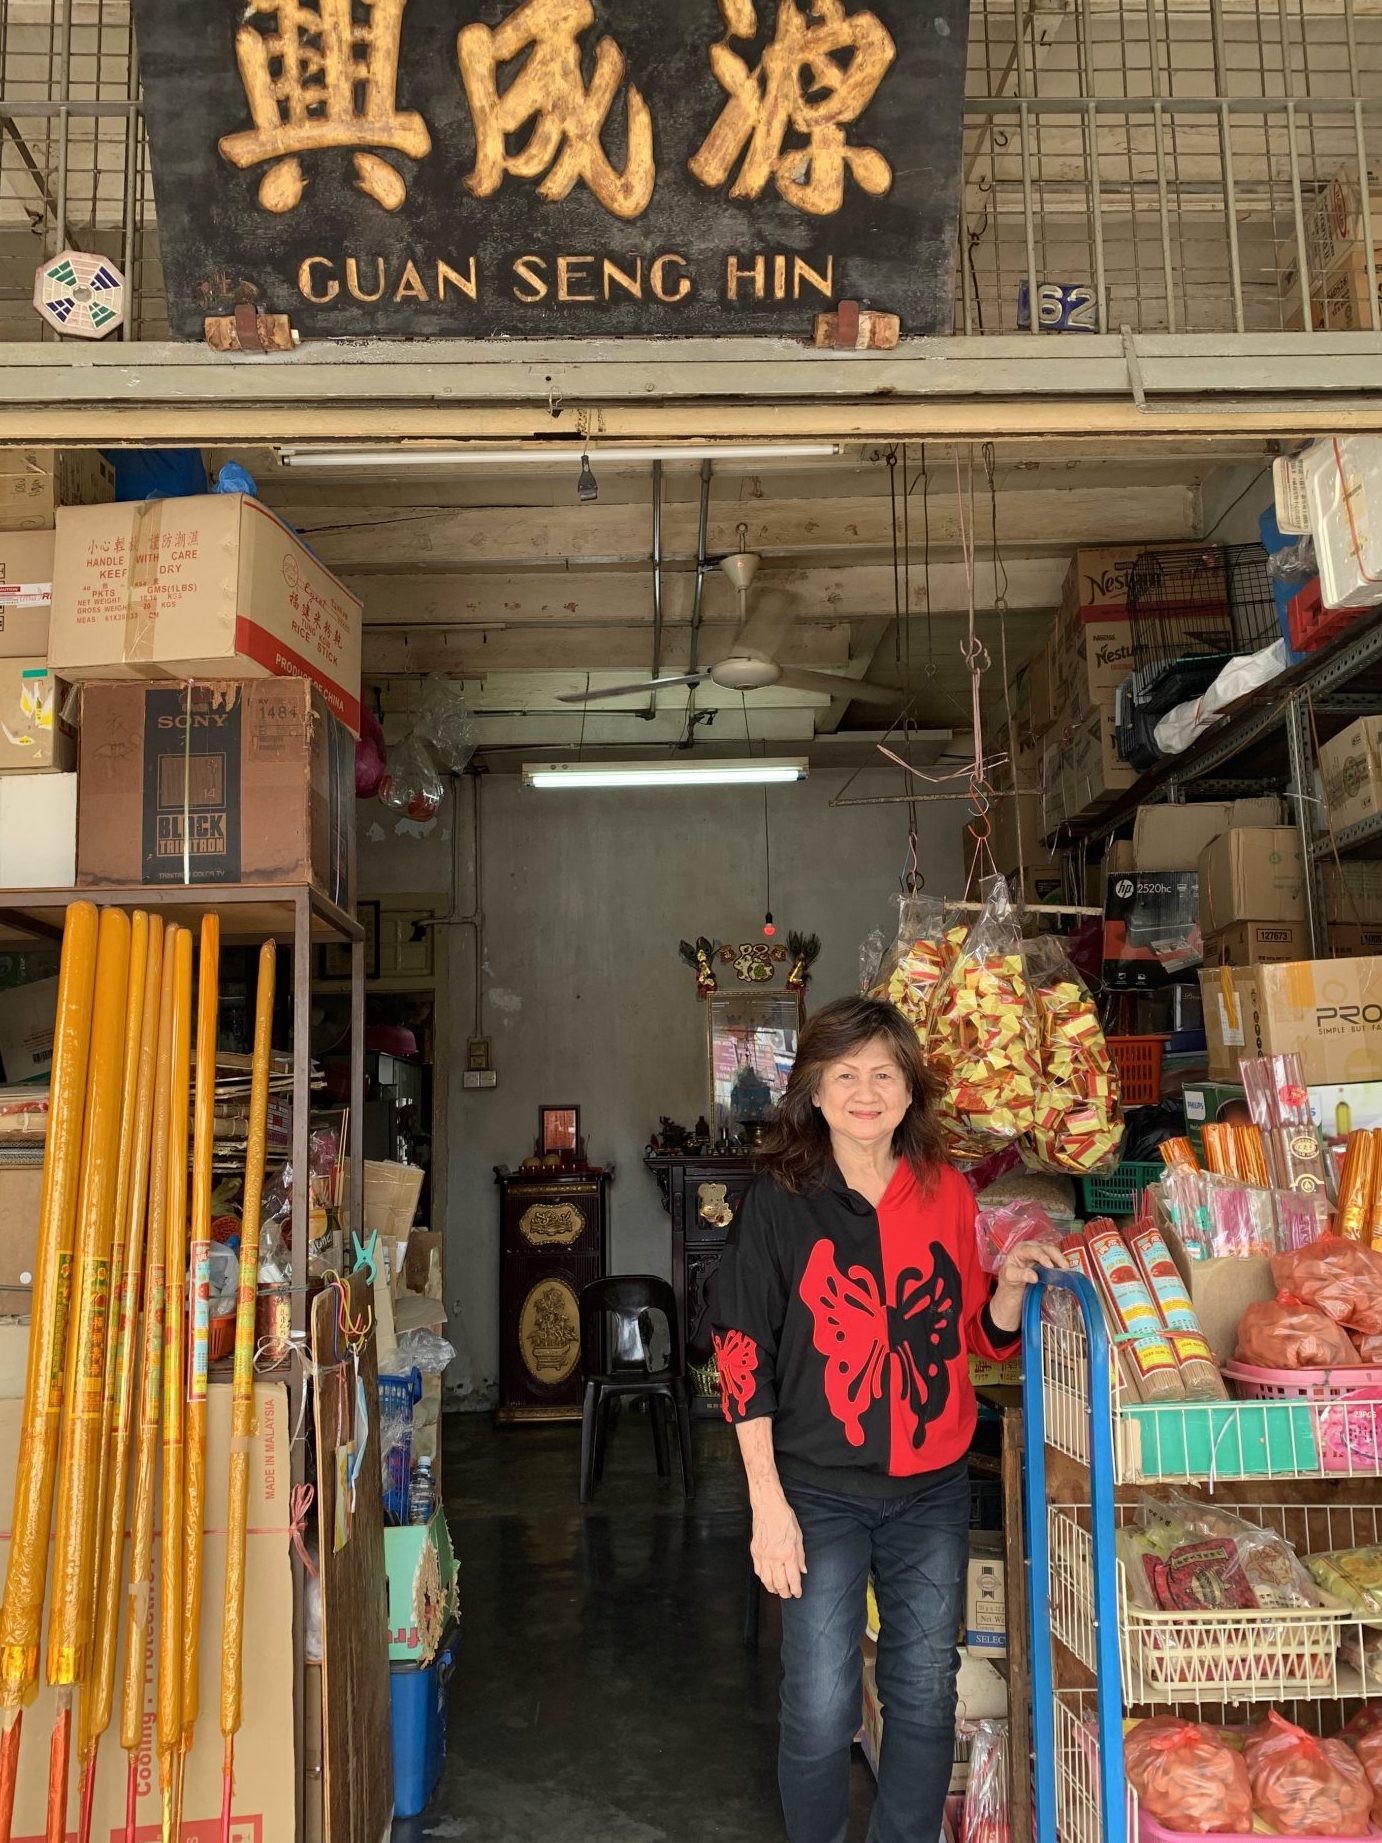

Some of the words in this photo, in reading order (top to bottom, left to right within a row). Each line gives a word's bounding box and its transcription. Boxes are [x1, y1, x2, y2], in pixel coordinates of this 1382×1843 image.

[299, 256, 479, 303] GUAN
[513, 255, 692, 302] SENG
[726, 254, 833, 300] HIN
[1038, 284, 1097, 329] 62
[87, 556, 125, 568] HANDLE
[136, 554, 160, 565] WITH
[171, 550, 198, 561] CARE
[159, 564, 182, 575] DRY
[92, 590, 116, 599] PKTS
[94, 597, 121, 605] WEIGHT
[77, 606, 101, 615] GROSS
[161, 600, 176, 609] KGS
[76, 616, 96, 625] MEAS
[291, 620, 311, 643] RICE
[316, 642, 339, 667] STICK
[323, 688, 345, 713] CHINA
[260, 706, 297, 719] 1484
[157, 714, 228, 729] SONY
[1118, 880, 1134, 898] hp
[1137, 883, 1173, 894] 2520hc
[1318, 1027, 1346, 1036] SIMPLE
[1351, 1025, 1366, 1033] BUT
[264, 1399, 275, 1453] MALAYSIA
[264, 1455, 275, 1466] IN
[264, 1469, 275, 1500] MADE
